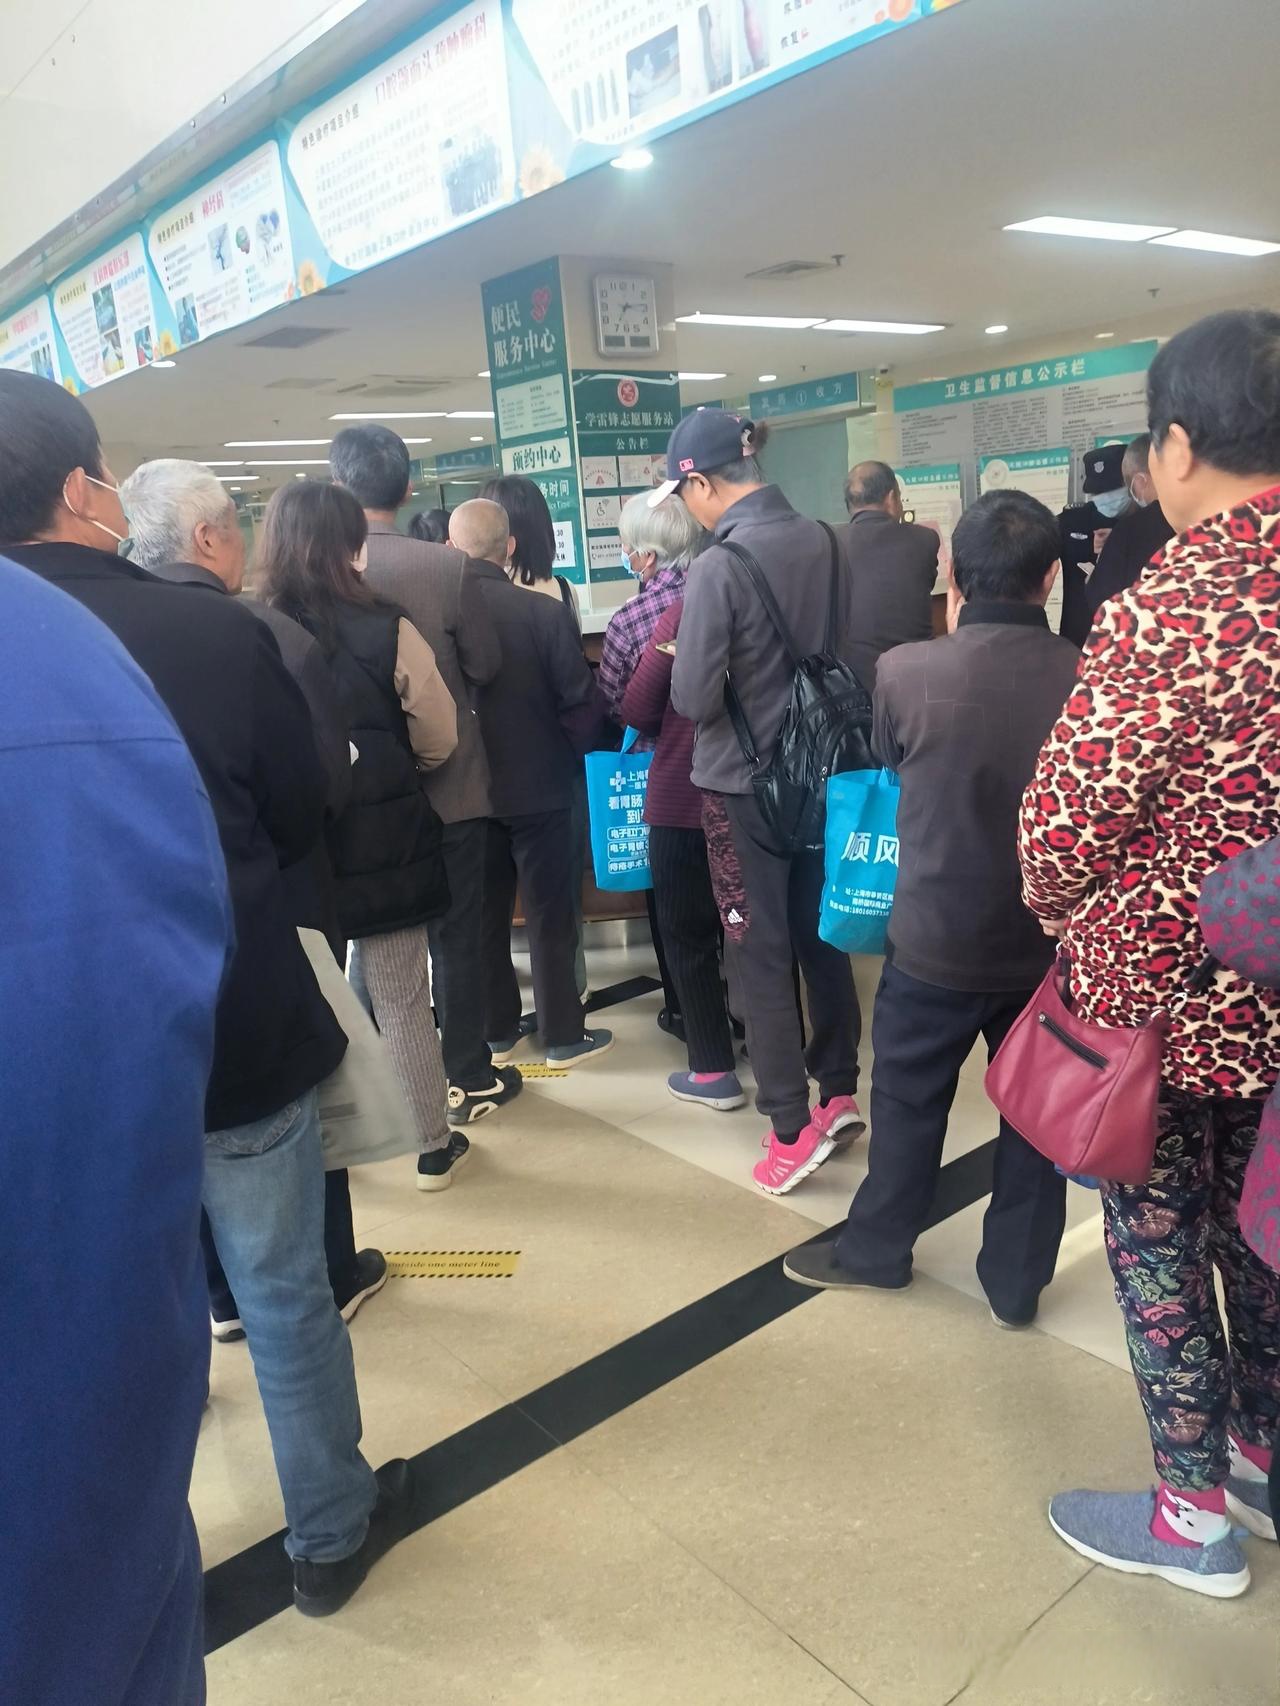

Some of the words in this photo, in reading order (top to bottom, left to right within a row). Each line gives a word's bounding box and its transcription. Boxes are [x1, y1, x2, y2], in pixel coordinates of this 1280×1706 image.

[491, 300, 521, 334] 便民
[493, 328, 556, 368] 服务中心
[945, 358, 1086, 399] 卫生监督信息公示栏
[585, 411, 674, 429] 学雷锋志愿服务站
[512, 445, 561, 472] 预约中心
[626, 809, 644, 824] 到
[841, 831, 900, 867] 顺风
